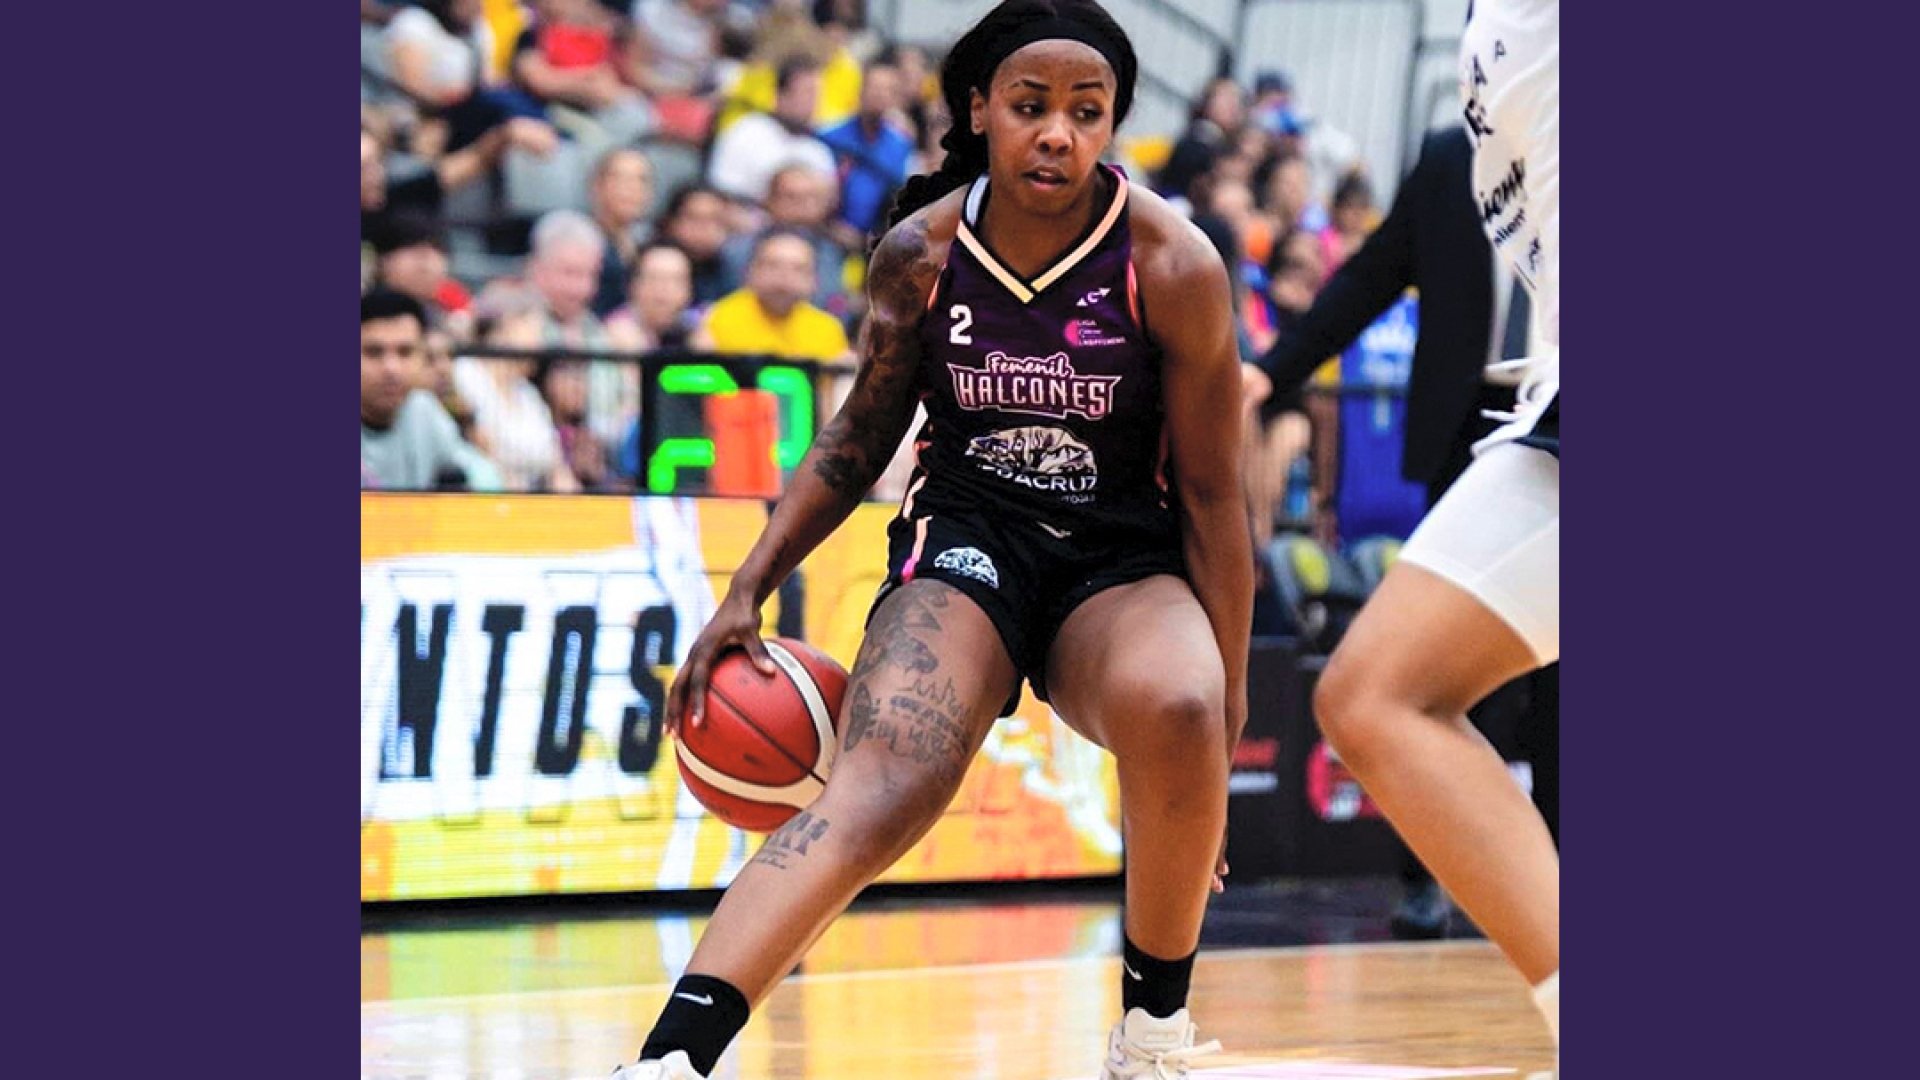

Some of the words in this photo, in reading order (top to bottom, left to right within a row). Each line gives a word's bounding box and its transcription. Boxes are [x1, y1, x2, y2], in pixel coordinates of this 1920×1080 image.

[949, 304, 973, 346] 2
[990, 355, 1071, 378] Femenil
[958, 372, 1107, 417] HALCONES
